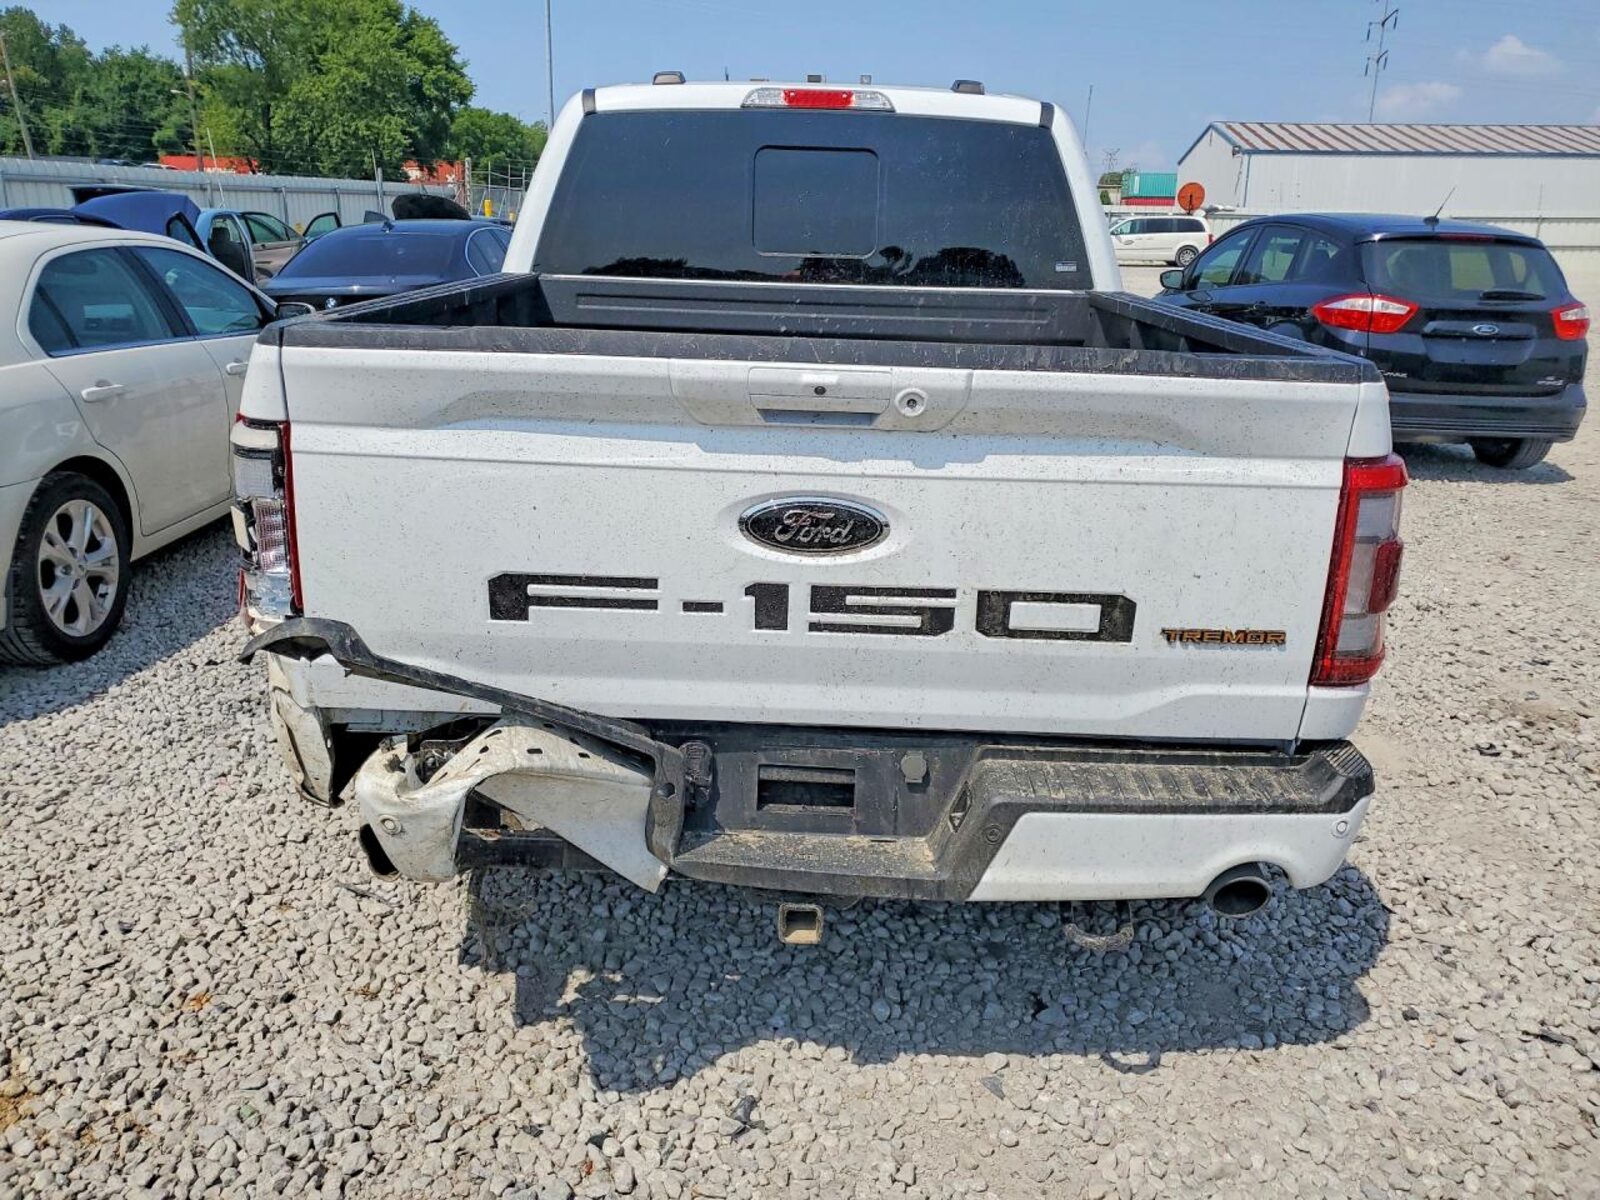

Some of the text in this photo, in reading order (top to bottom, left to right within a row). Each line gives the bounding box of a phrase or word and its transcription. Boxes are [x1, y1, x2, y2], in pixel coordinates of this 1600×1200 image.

[774, 509, 855, 543] Ford
[488, 573, 1137, 643] F-150
[1160, 628, 1287, 645] TREMOR
